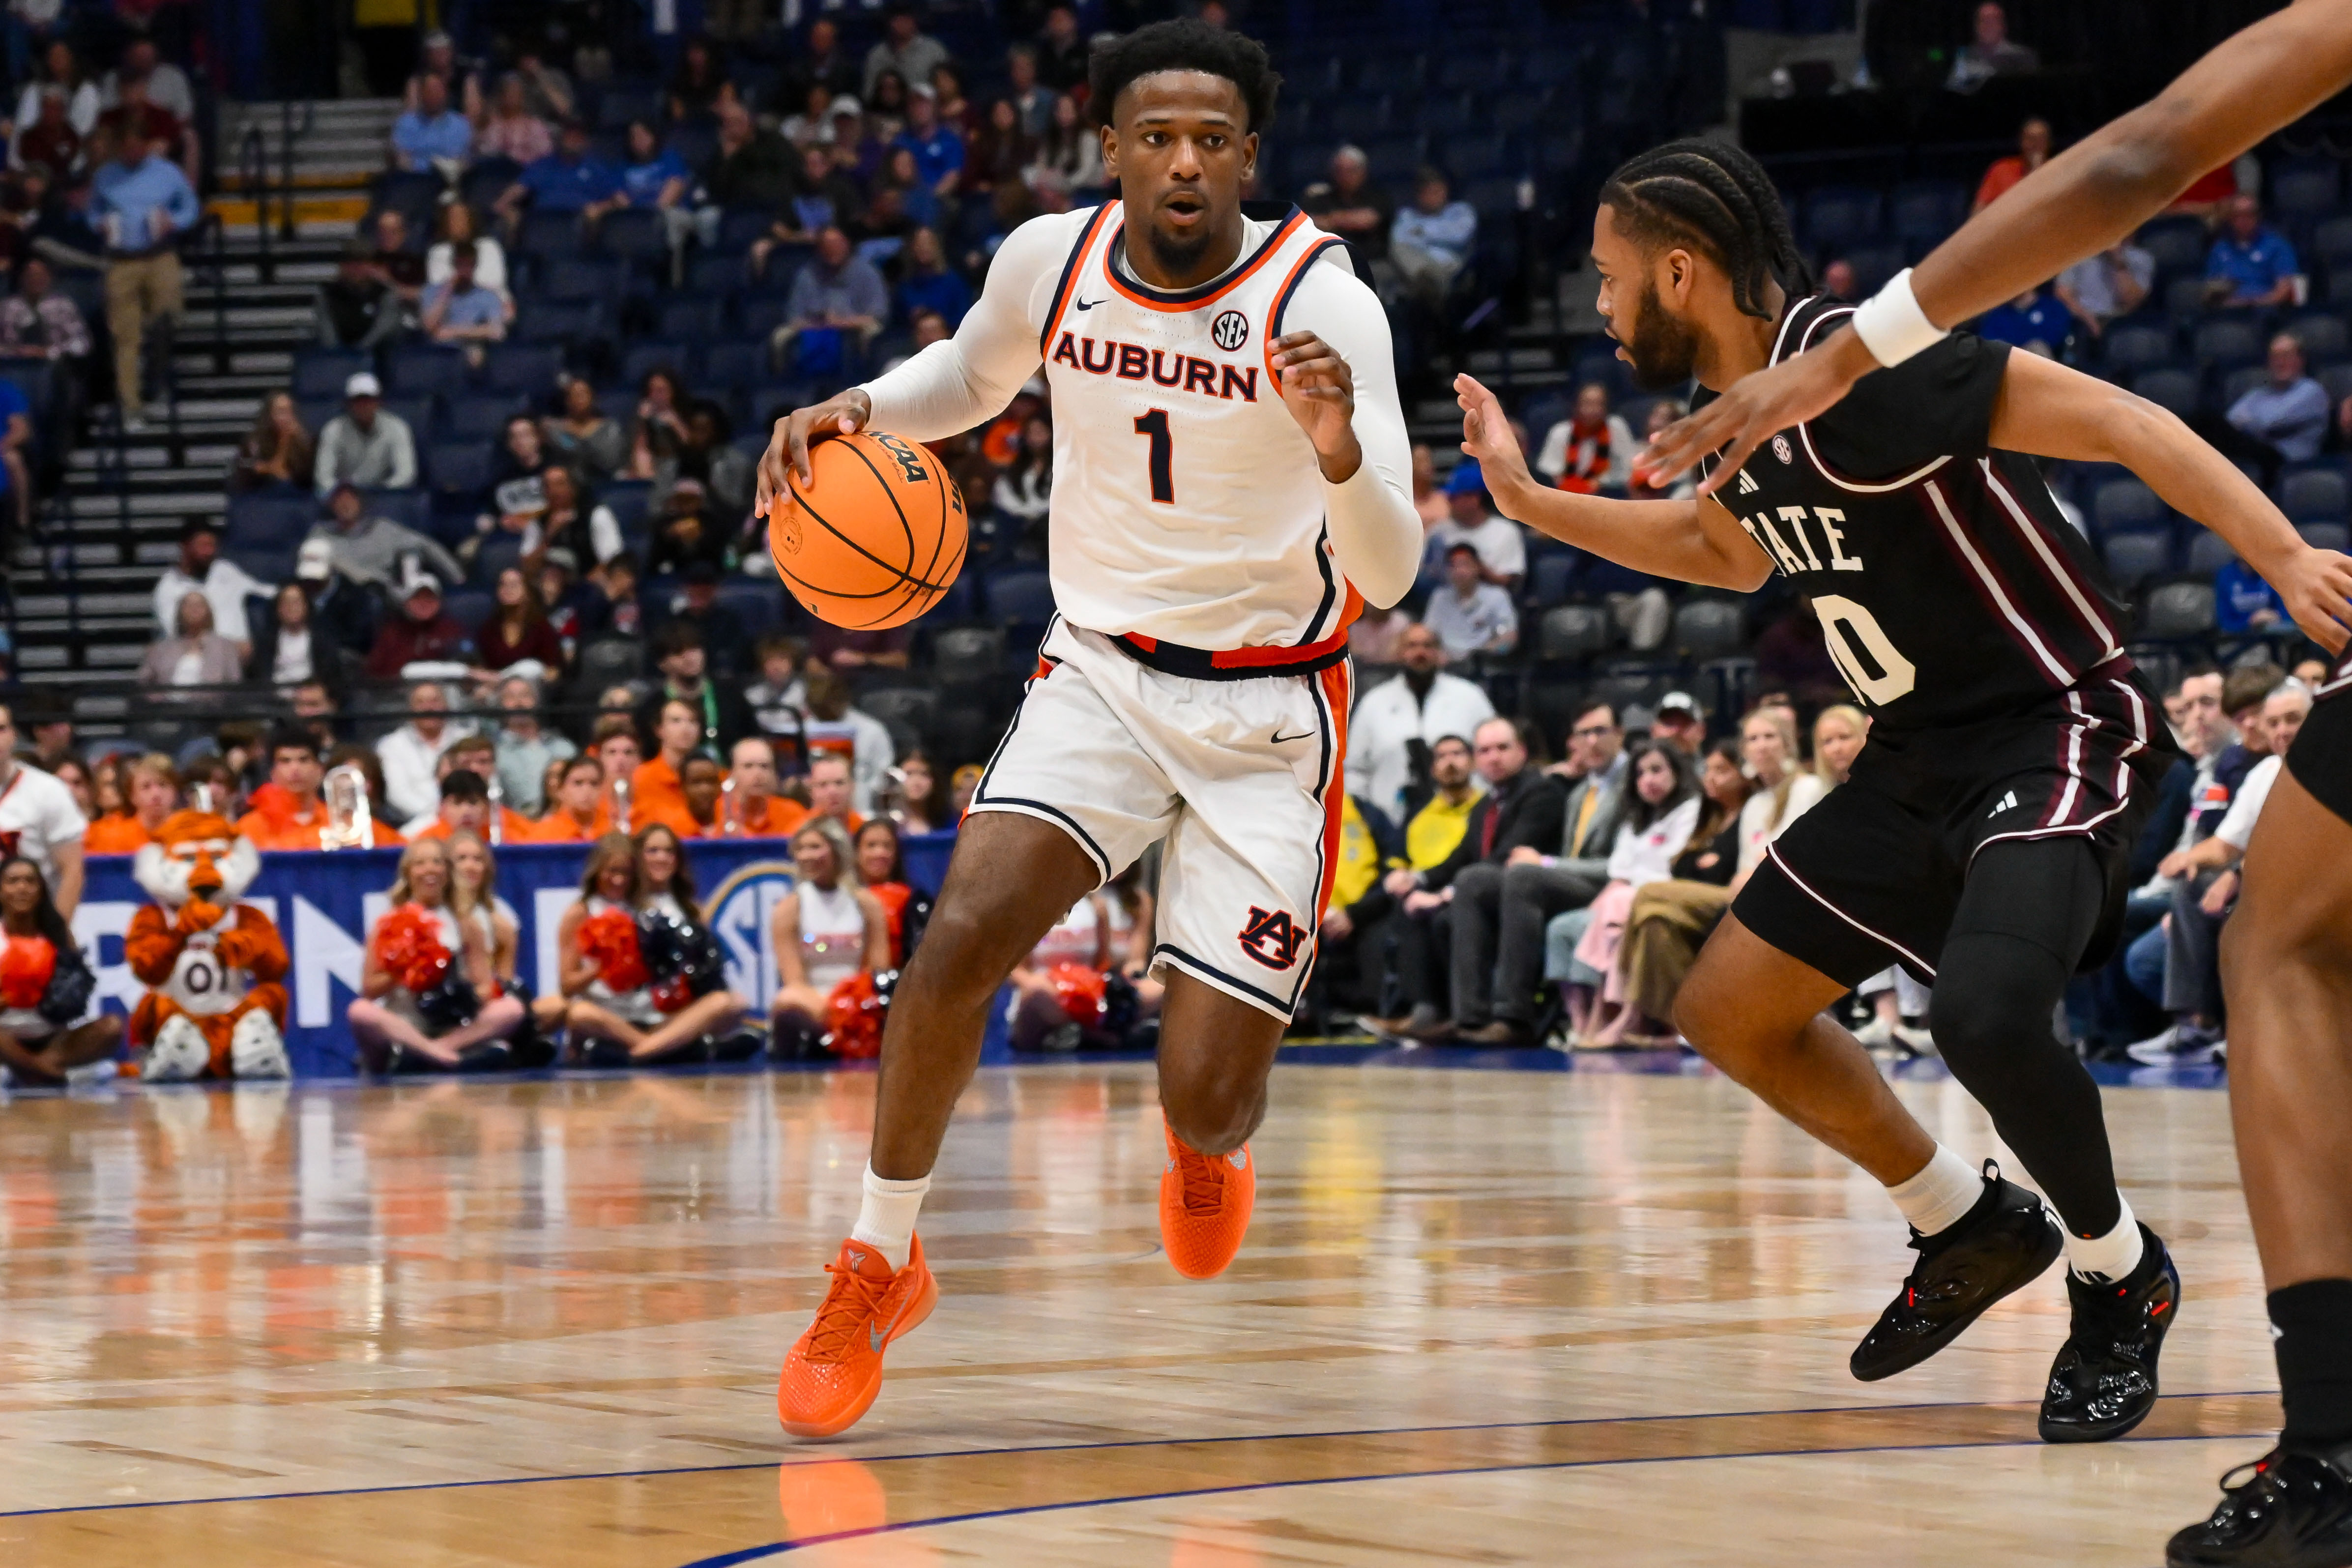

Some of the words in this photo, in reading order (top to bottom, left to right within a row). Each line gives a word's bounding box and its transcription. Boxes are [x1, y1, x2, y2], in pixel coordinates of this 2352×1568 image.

[1215, 313, 1247, 348] SEC
[1053, 331, 1259, 402] AUBURN
[1133, 407, 1175, 504] 1
